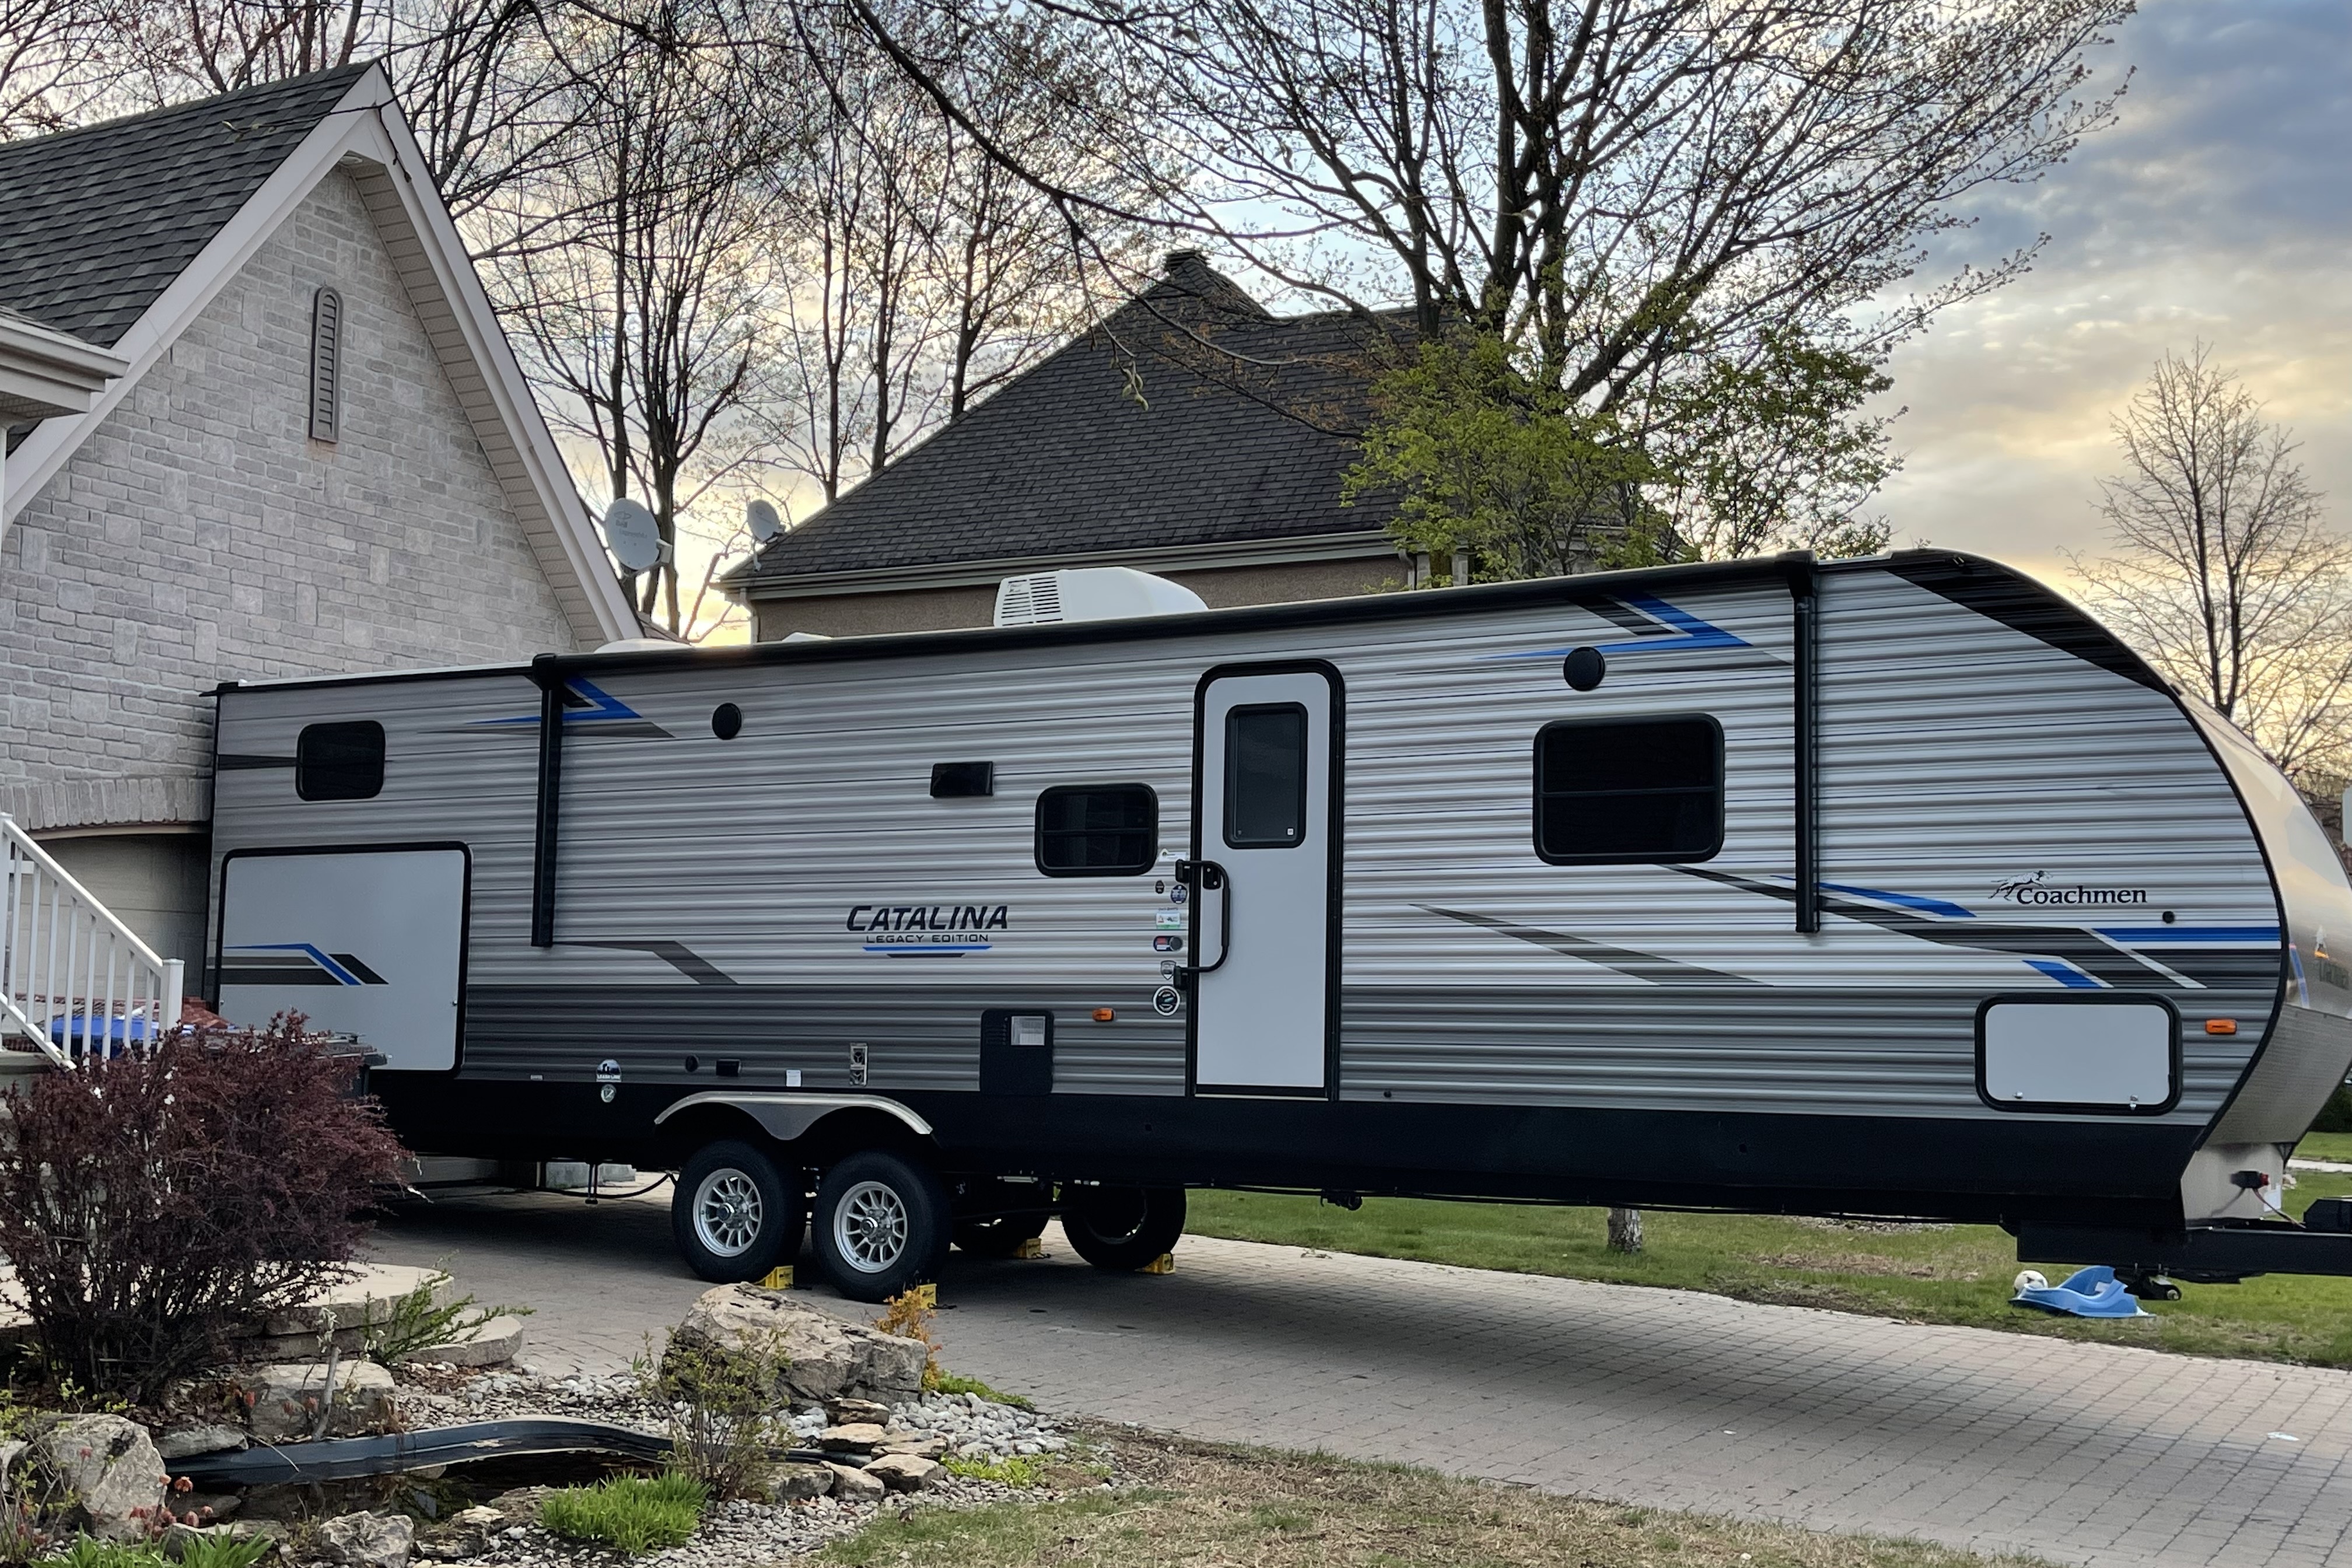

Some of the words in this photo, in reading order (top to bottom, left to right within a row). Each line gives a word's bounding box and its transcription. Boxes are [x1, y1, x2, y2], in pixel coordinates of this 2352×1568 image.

[2017, 886, 2147, 904] Coachmen
[846, 905, 1008, 932] CATALINA
[867, 935, 924, 943] LEGACY
[932, 934, 989, 943] EDITION
